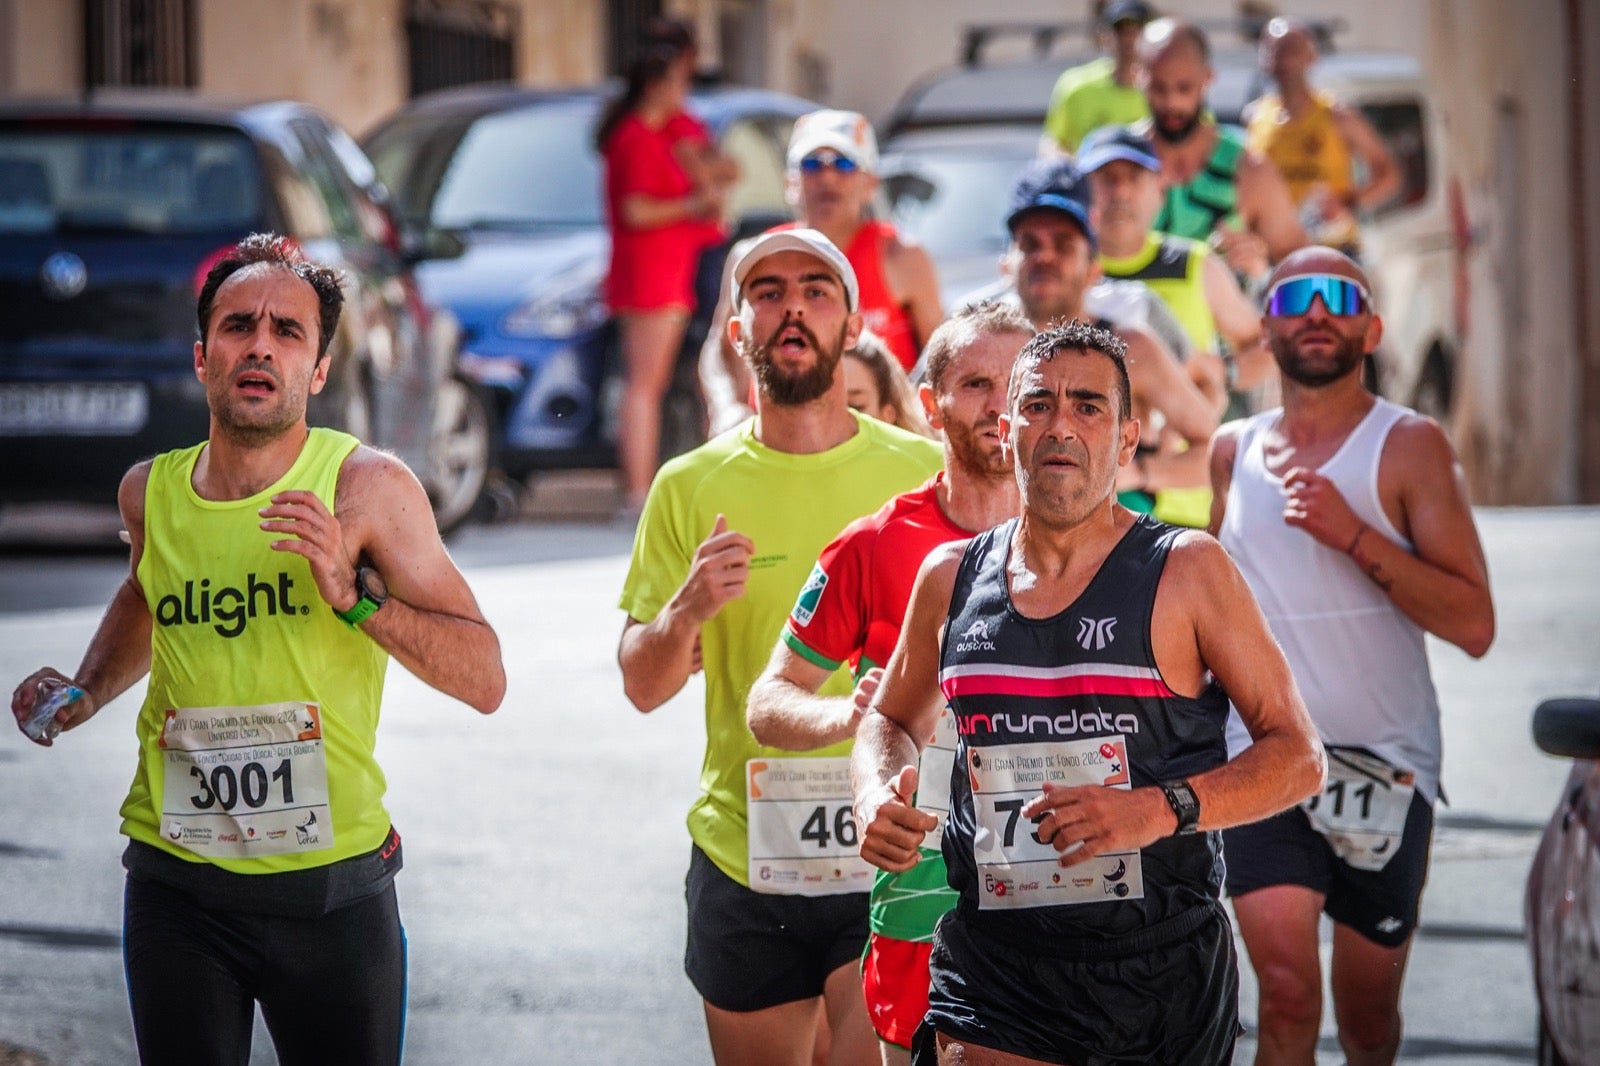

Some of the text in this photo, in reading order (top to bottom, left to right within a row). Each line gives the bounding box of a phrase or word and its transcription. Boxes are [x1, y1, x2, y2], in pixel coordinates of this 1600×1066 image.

[994, 759, 1015, 772] GRAN
[1017, 755, 1043, 770] PREMIO
[1045, 756, 1055, 768] DE
[1057, 754, 1081, 768] FONDO
[190, 758, 294, 811] 3001
[1014, 769, 1066, 784] UNIVERSO LORCA
